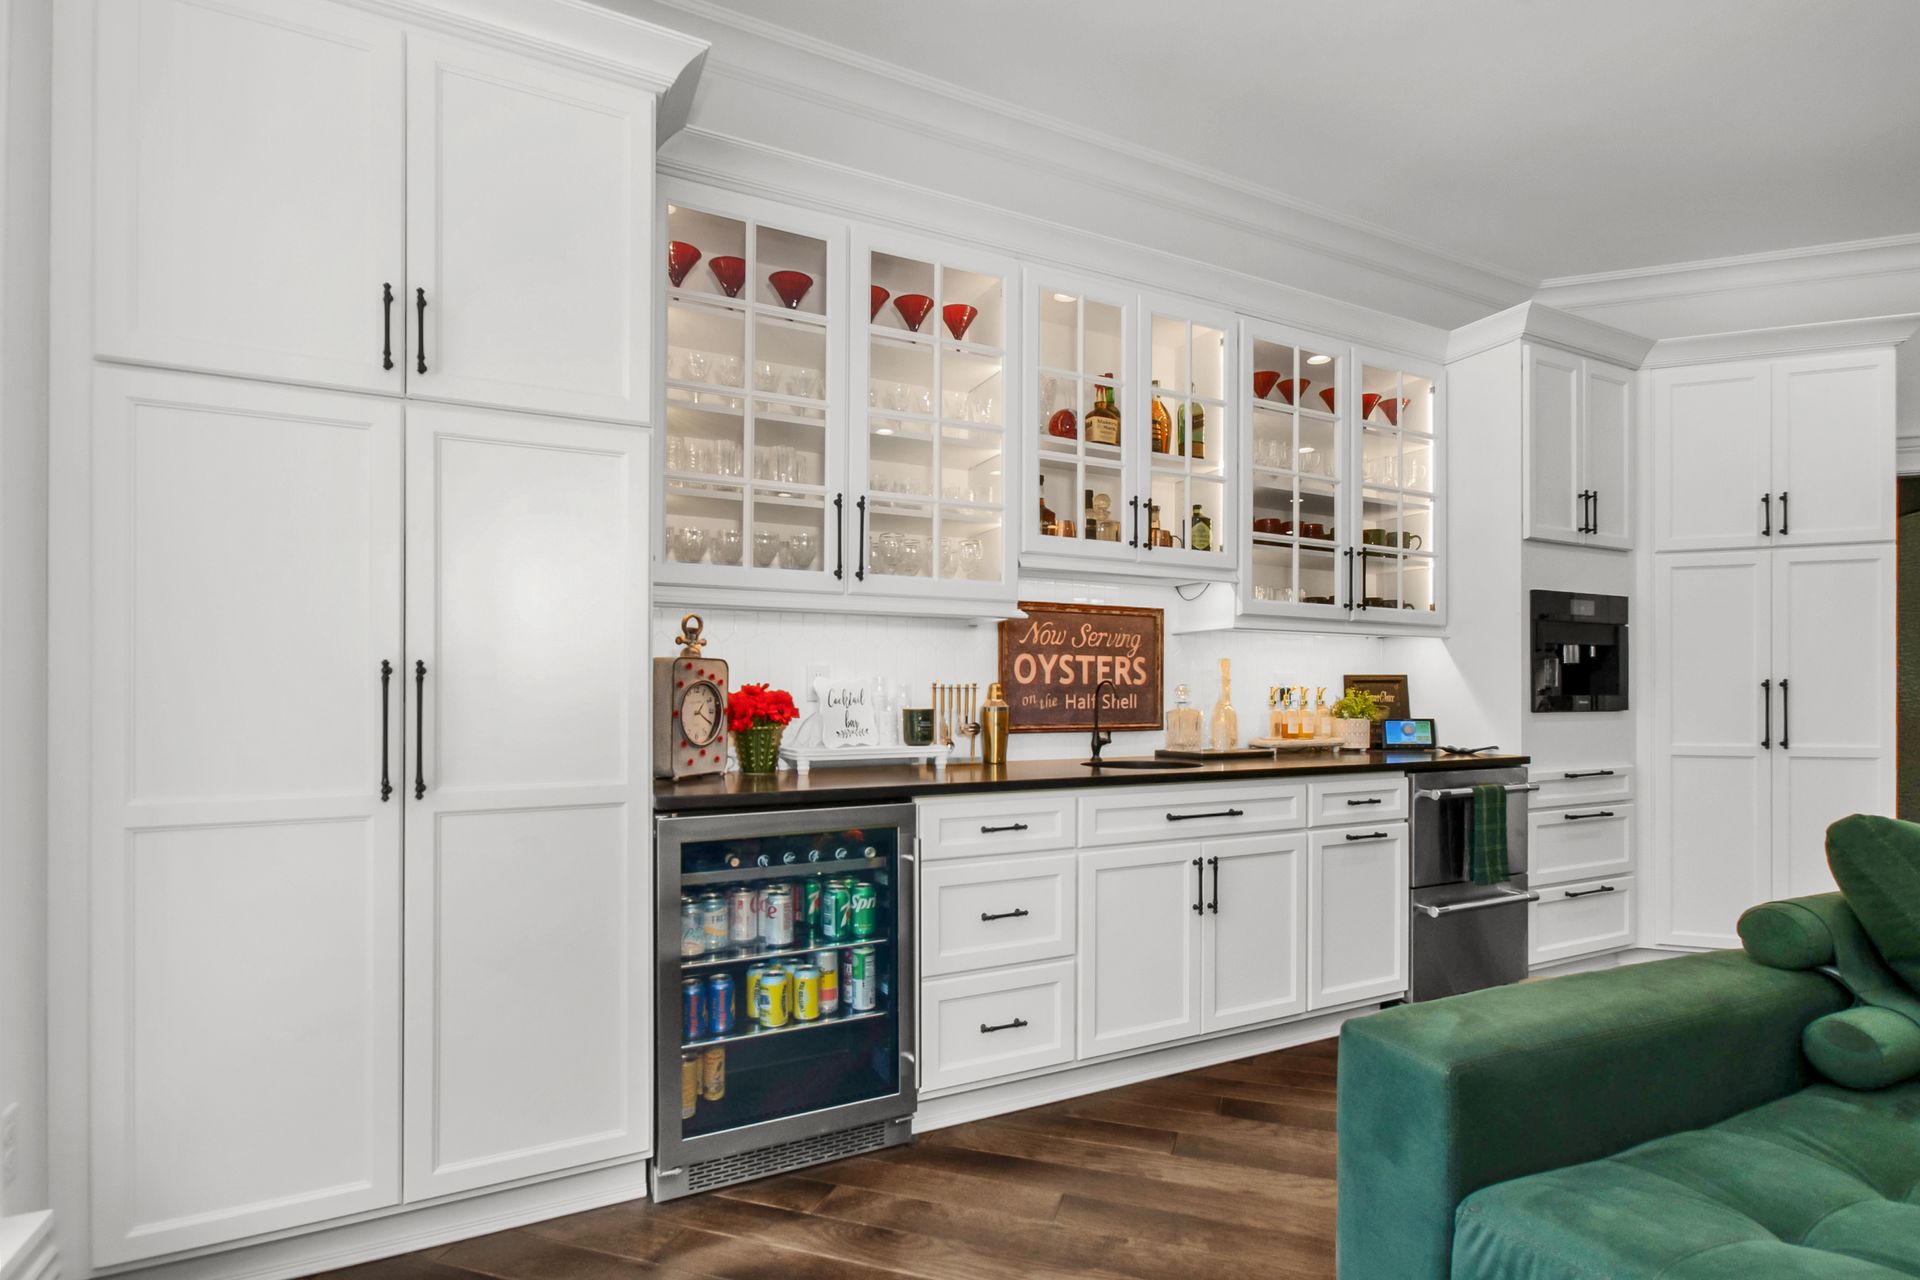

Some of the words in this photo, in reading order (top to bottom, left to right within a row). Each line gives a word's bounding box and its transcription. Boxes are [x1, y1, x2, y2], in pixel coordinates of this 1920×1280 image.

[1019, 621, 1067, 646] Now
[1071, 623, 1143, 658] Serving
[1013, 653, 1147, 685] OYSTERS
[1022, 694, 1037, 707] on
[1040, 692, 1059, 710] the
[1065, 693, 1096, 710] Half
[1102, 693, 1138, 710] Shell
[844, 709, 861, 729] bar
